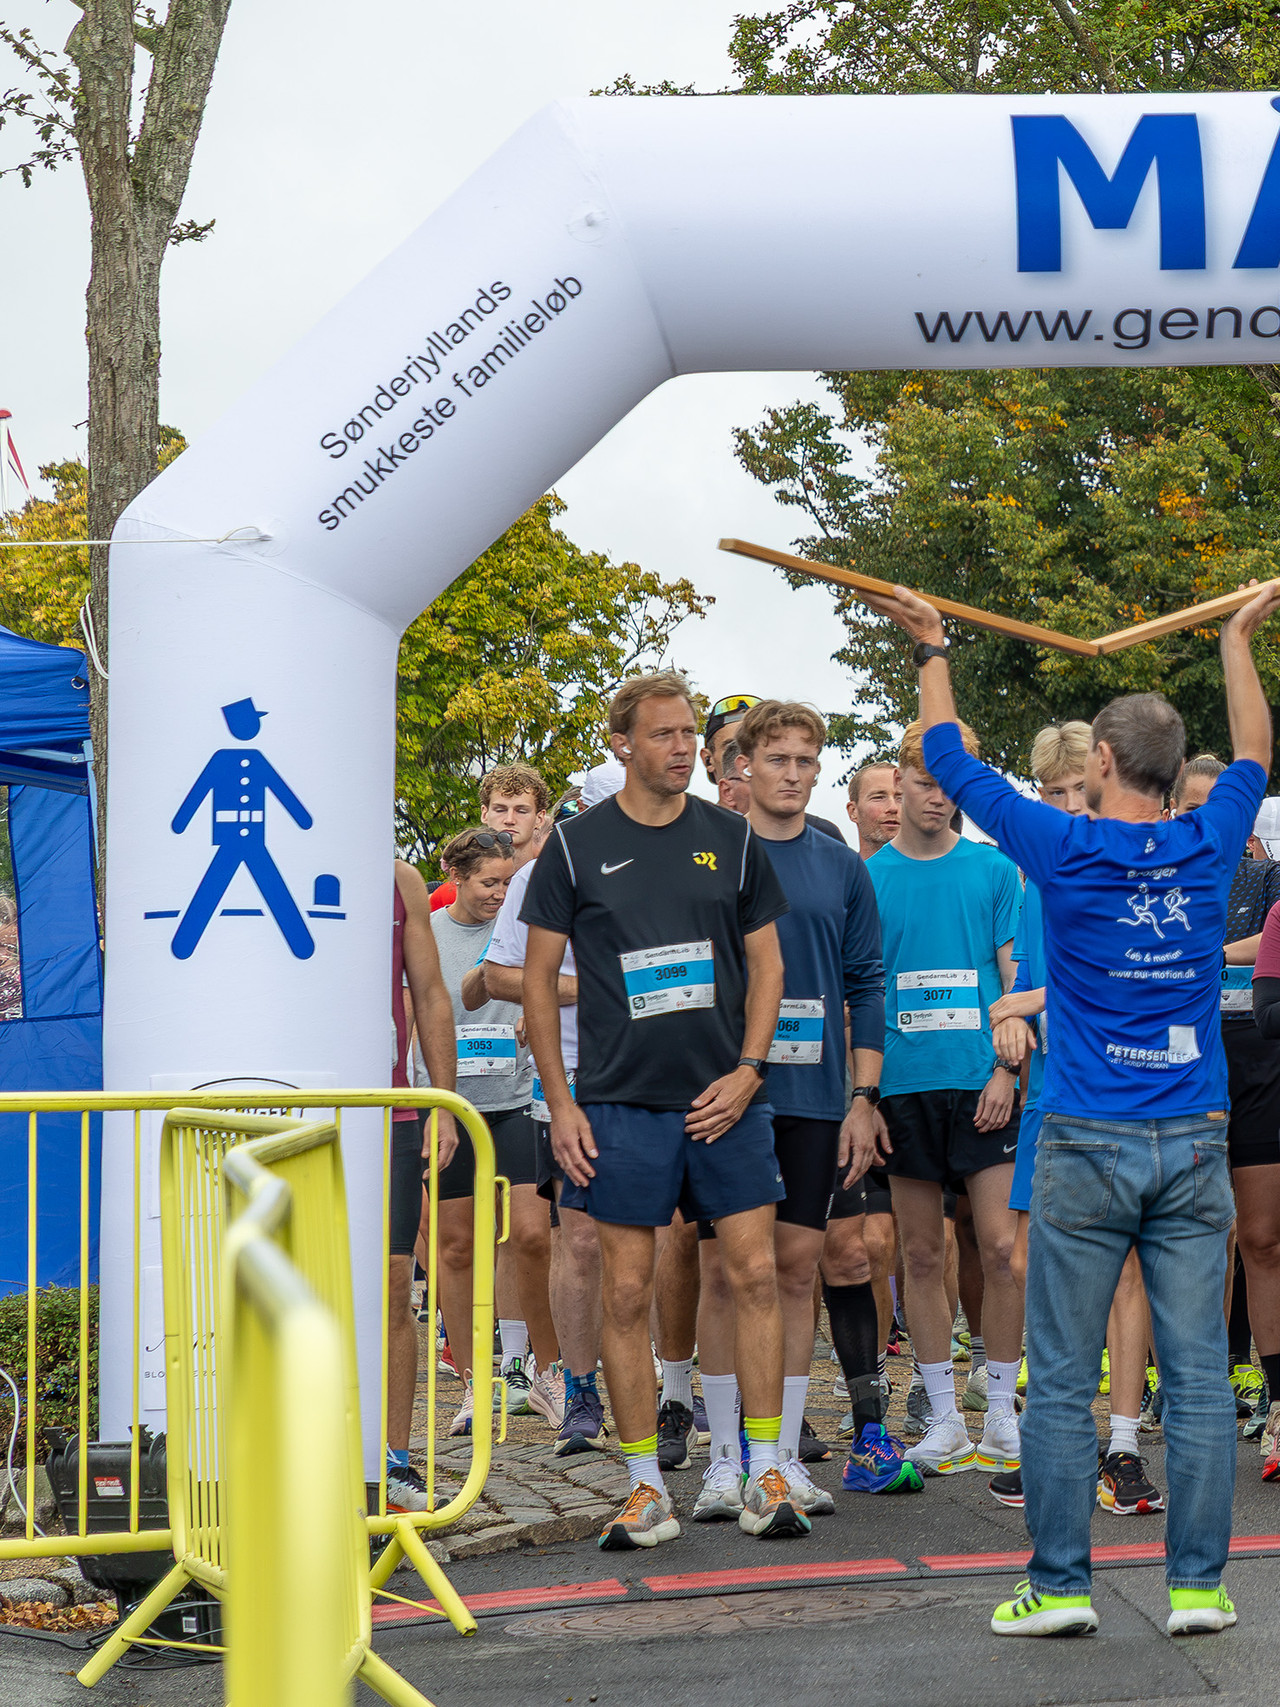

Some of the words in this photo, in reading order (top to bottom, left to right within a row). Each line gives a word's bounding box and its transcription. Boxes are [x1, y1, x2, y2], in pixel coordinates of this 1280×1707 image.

[320, 280, 512, 459] Sønderjyllands
[318, 397, 456, 531] smukkeste
[452, 276, 583, 398] familieløb
[654, 965, 688, 981] 3099
[923, 989, 953, 1001] 3077
[777, 1020, 800, 1032] 068
[467, 1040, 493, 1051] 3053
